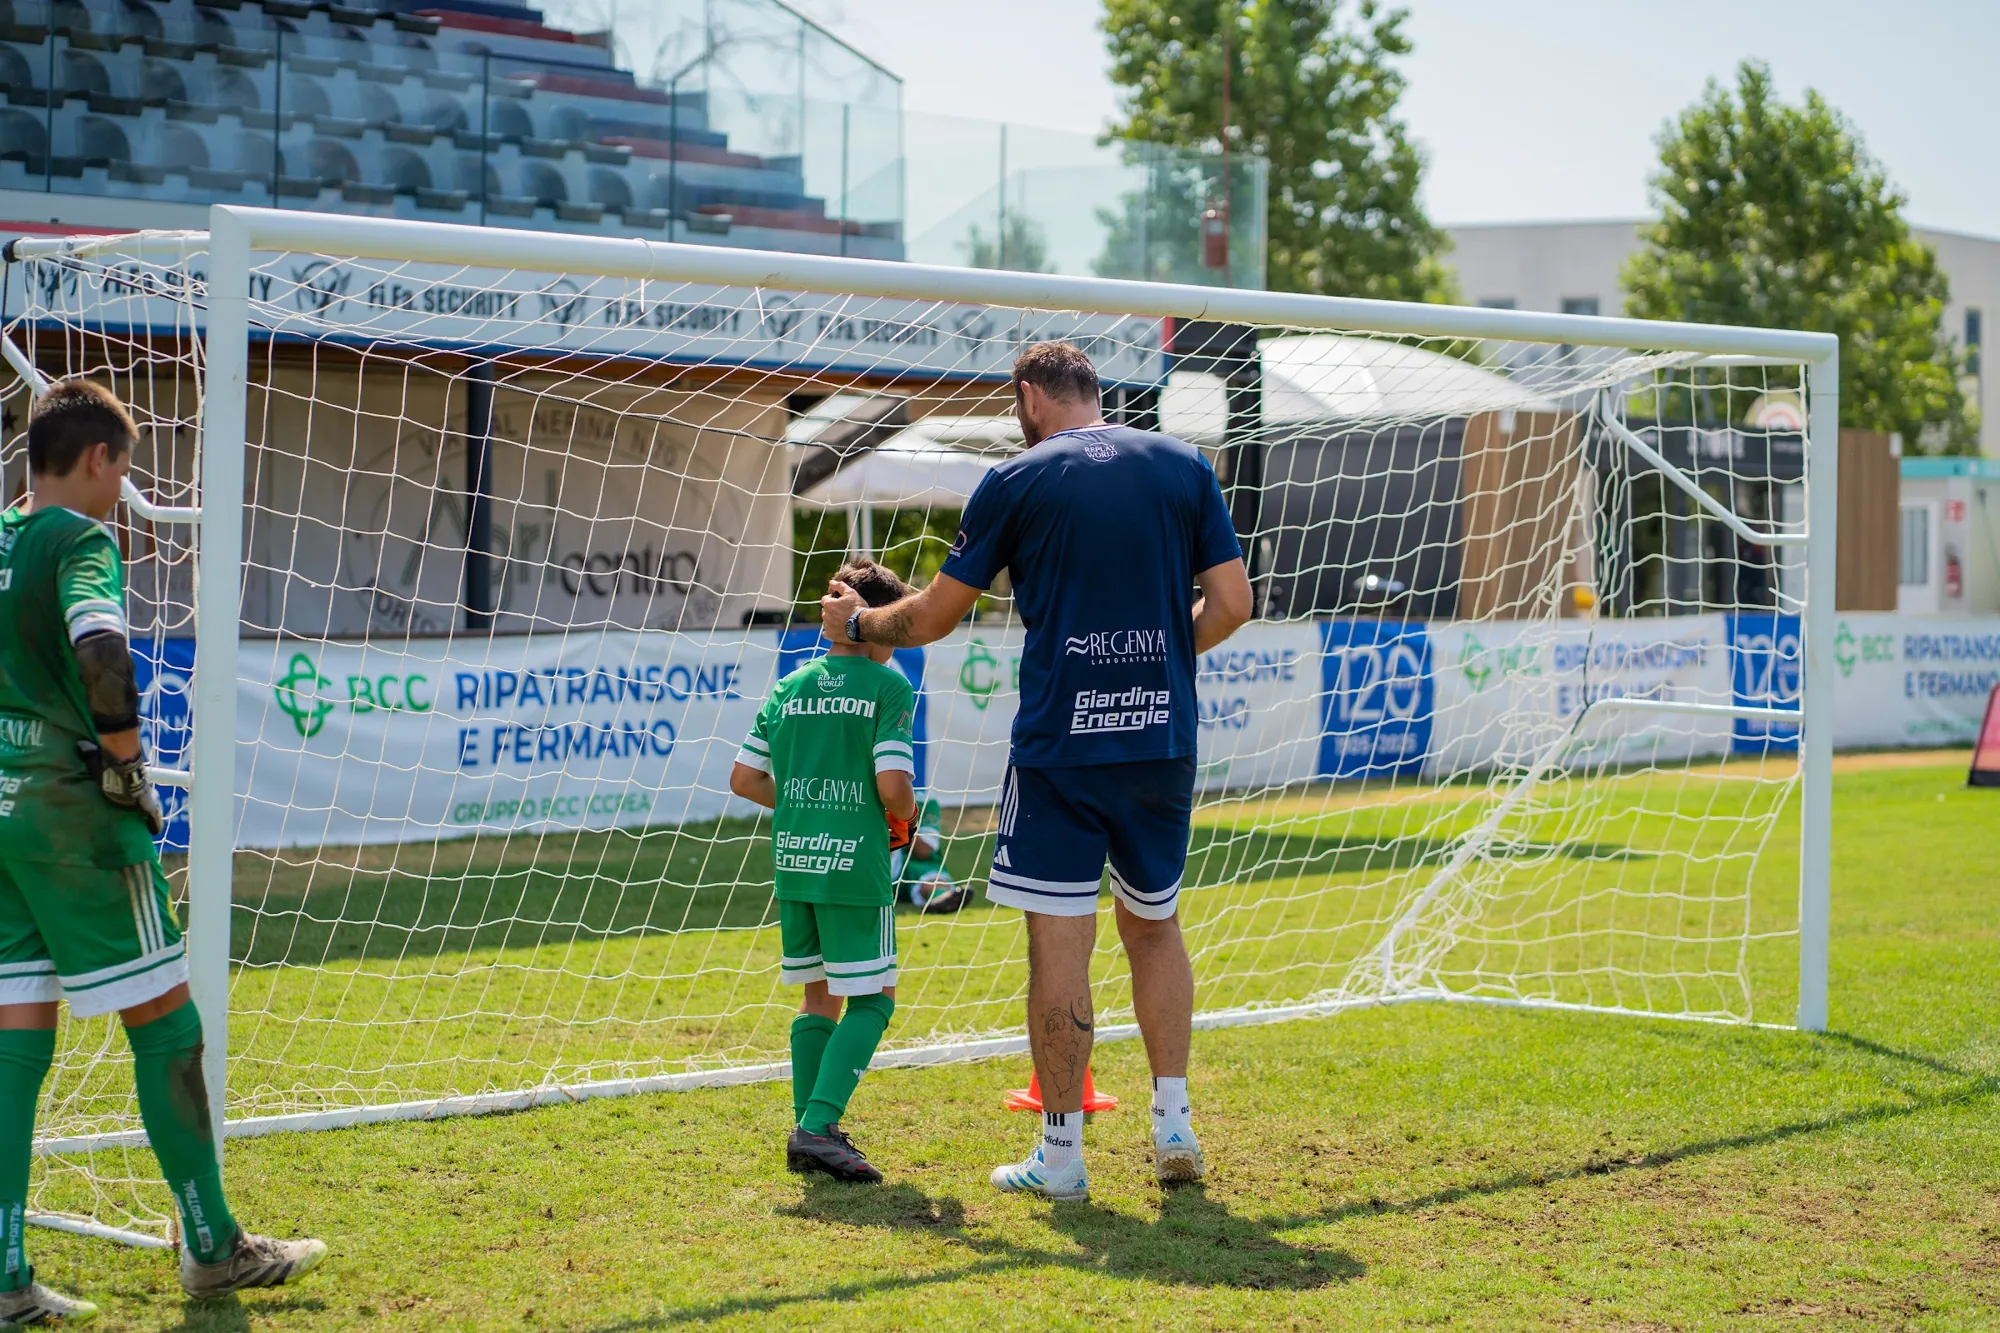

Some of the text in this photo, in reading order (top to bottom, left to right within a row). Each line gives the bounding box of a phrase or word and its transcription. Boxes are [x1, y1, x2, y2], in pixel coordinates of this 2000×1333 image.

[423, 286, 521, 318] SECURITY
[347, 673, 431, 715] BCC
[455, 663, 743, 711] RIPATRANSONE
[817, 680, 845, 688] WORLD
[1332, 643, 1422, 721] 120
[781, 696, 876, 719] PELLICCIONI
[1074, 686, 1170, 710] Giardina
[1069, 705, 1170, 735] Energie
[458, 718, 678, 767] E FERMANO
[789, 777, 867, 805] REGENYAL
[453, 791, 652, 823] GRUPPO BCC ICCREA
[775, 848, 855, 875] Energie
